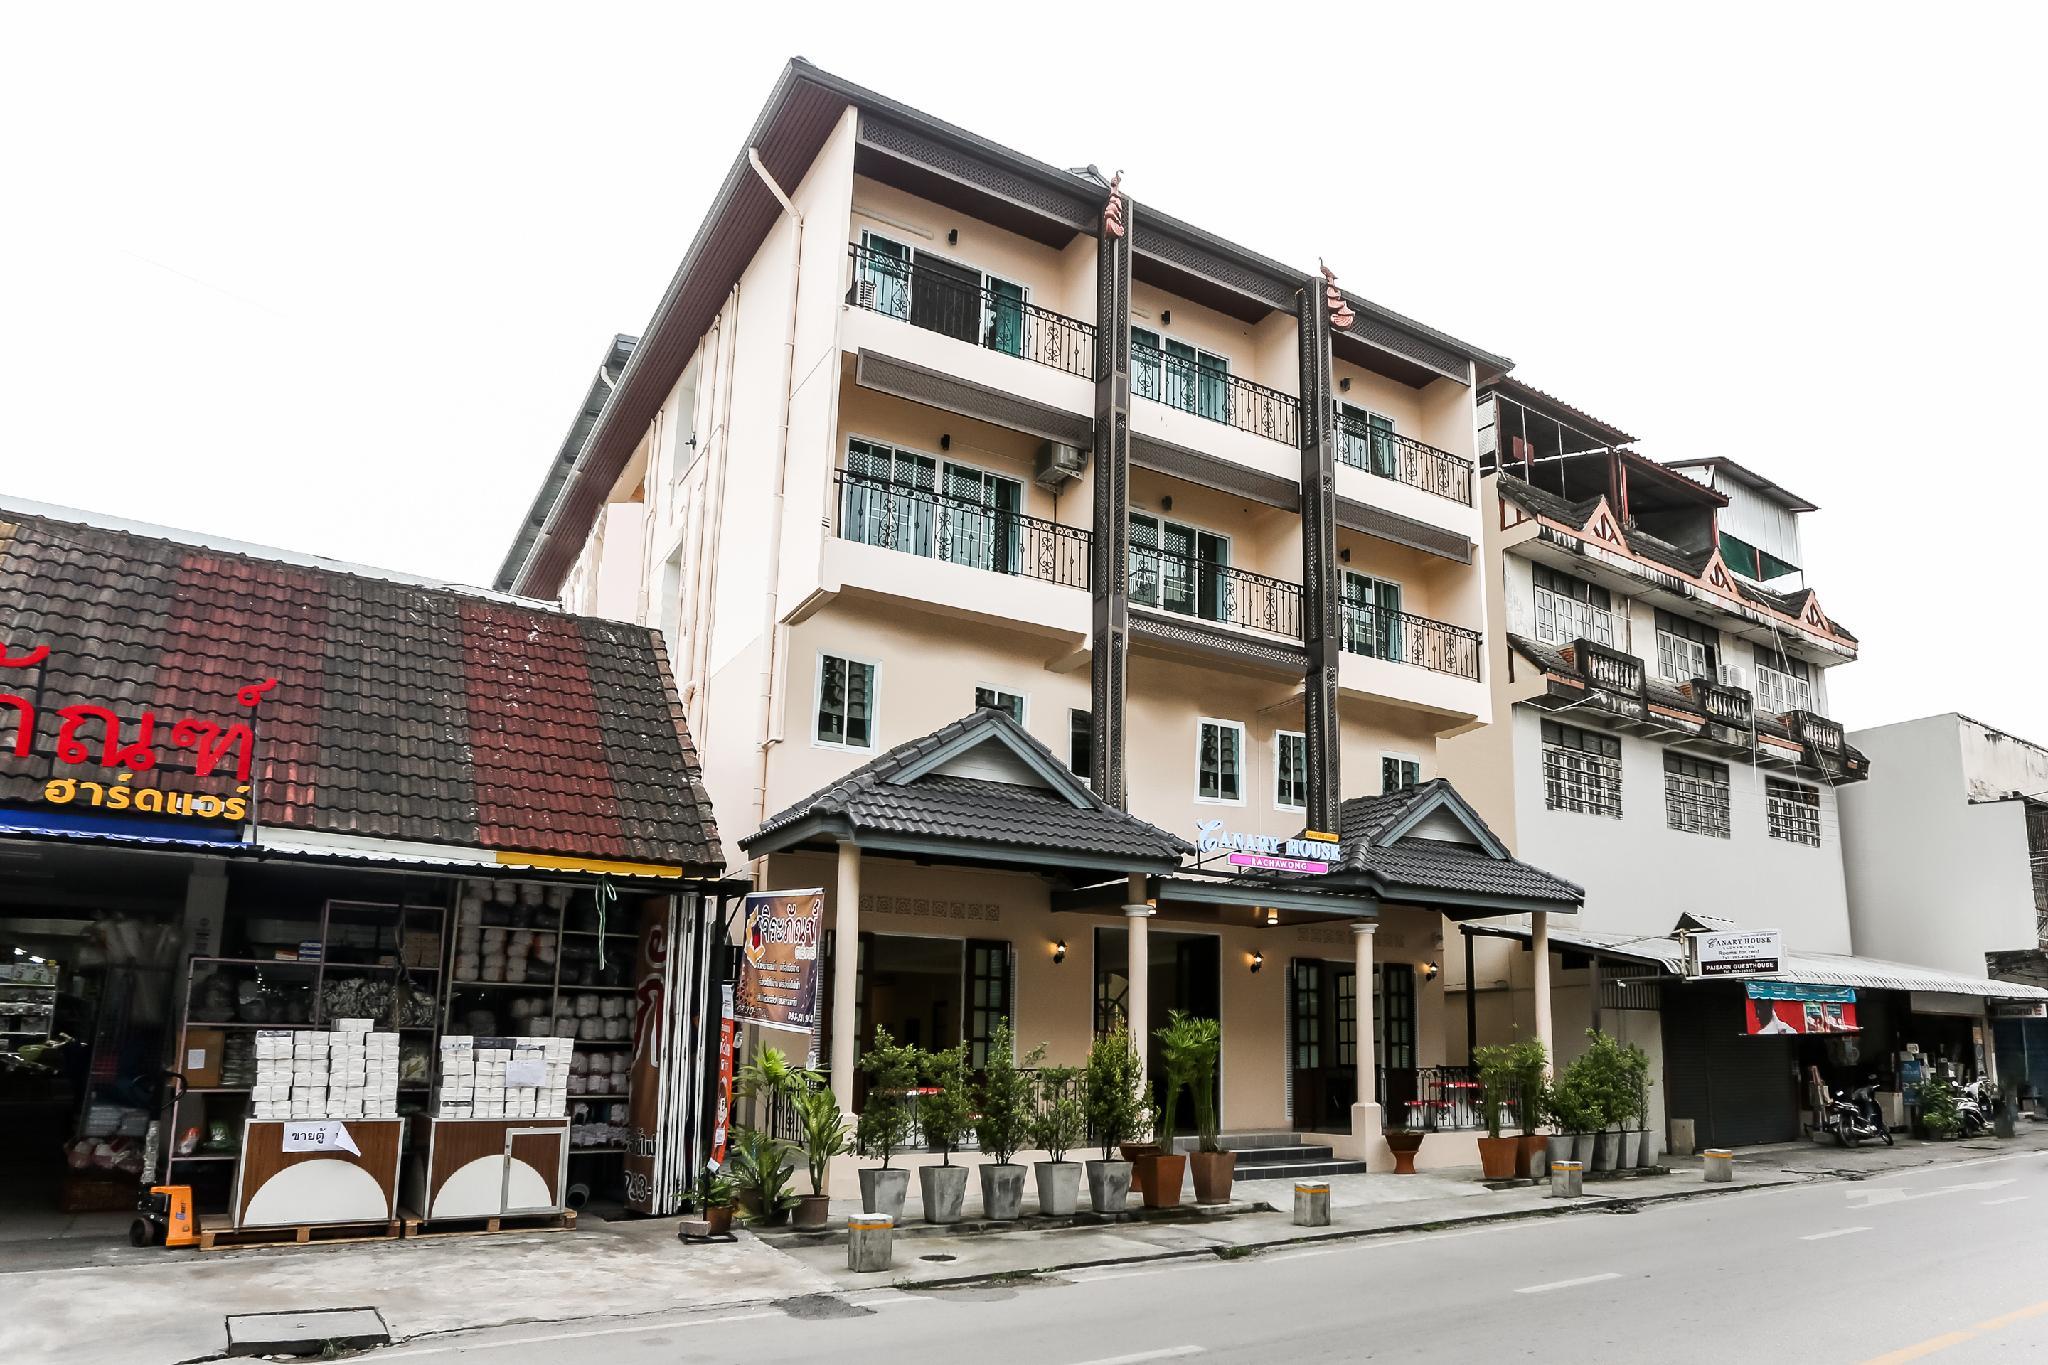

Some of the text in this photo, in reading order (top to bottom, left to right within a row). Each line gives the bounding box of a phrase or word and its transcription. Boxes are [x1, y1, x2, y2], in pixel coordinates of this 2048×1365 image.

[1195, 819, 1341, 861] CANARY HOUSE
[1251, 857, 1308, 870] RACHAWONG
[1707, 937, 1742, 948] CANARY
[1744, 937, 1772, 945] HOUSE
